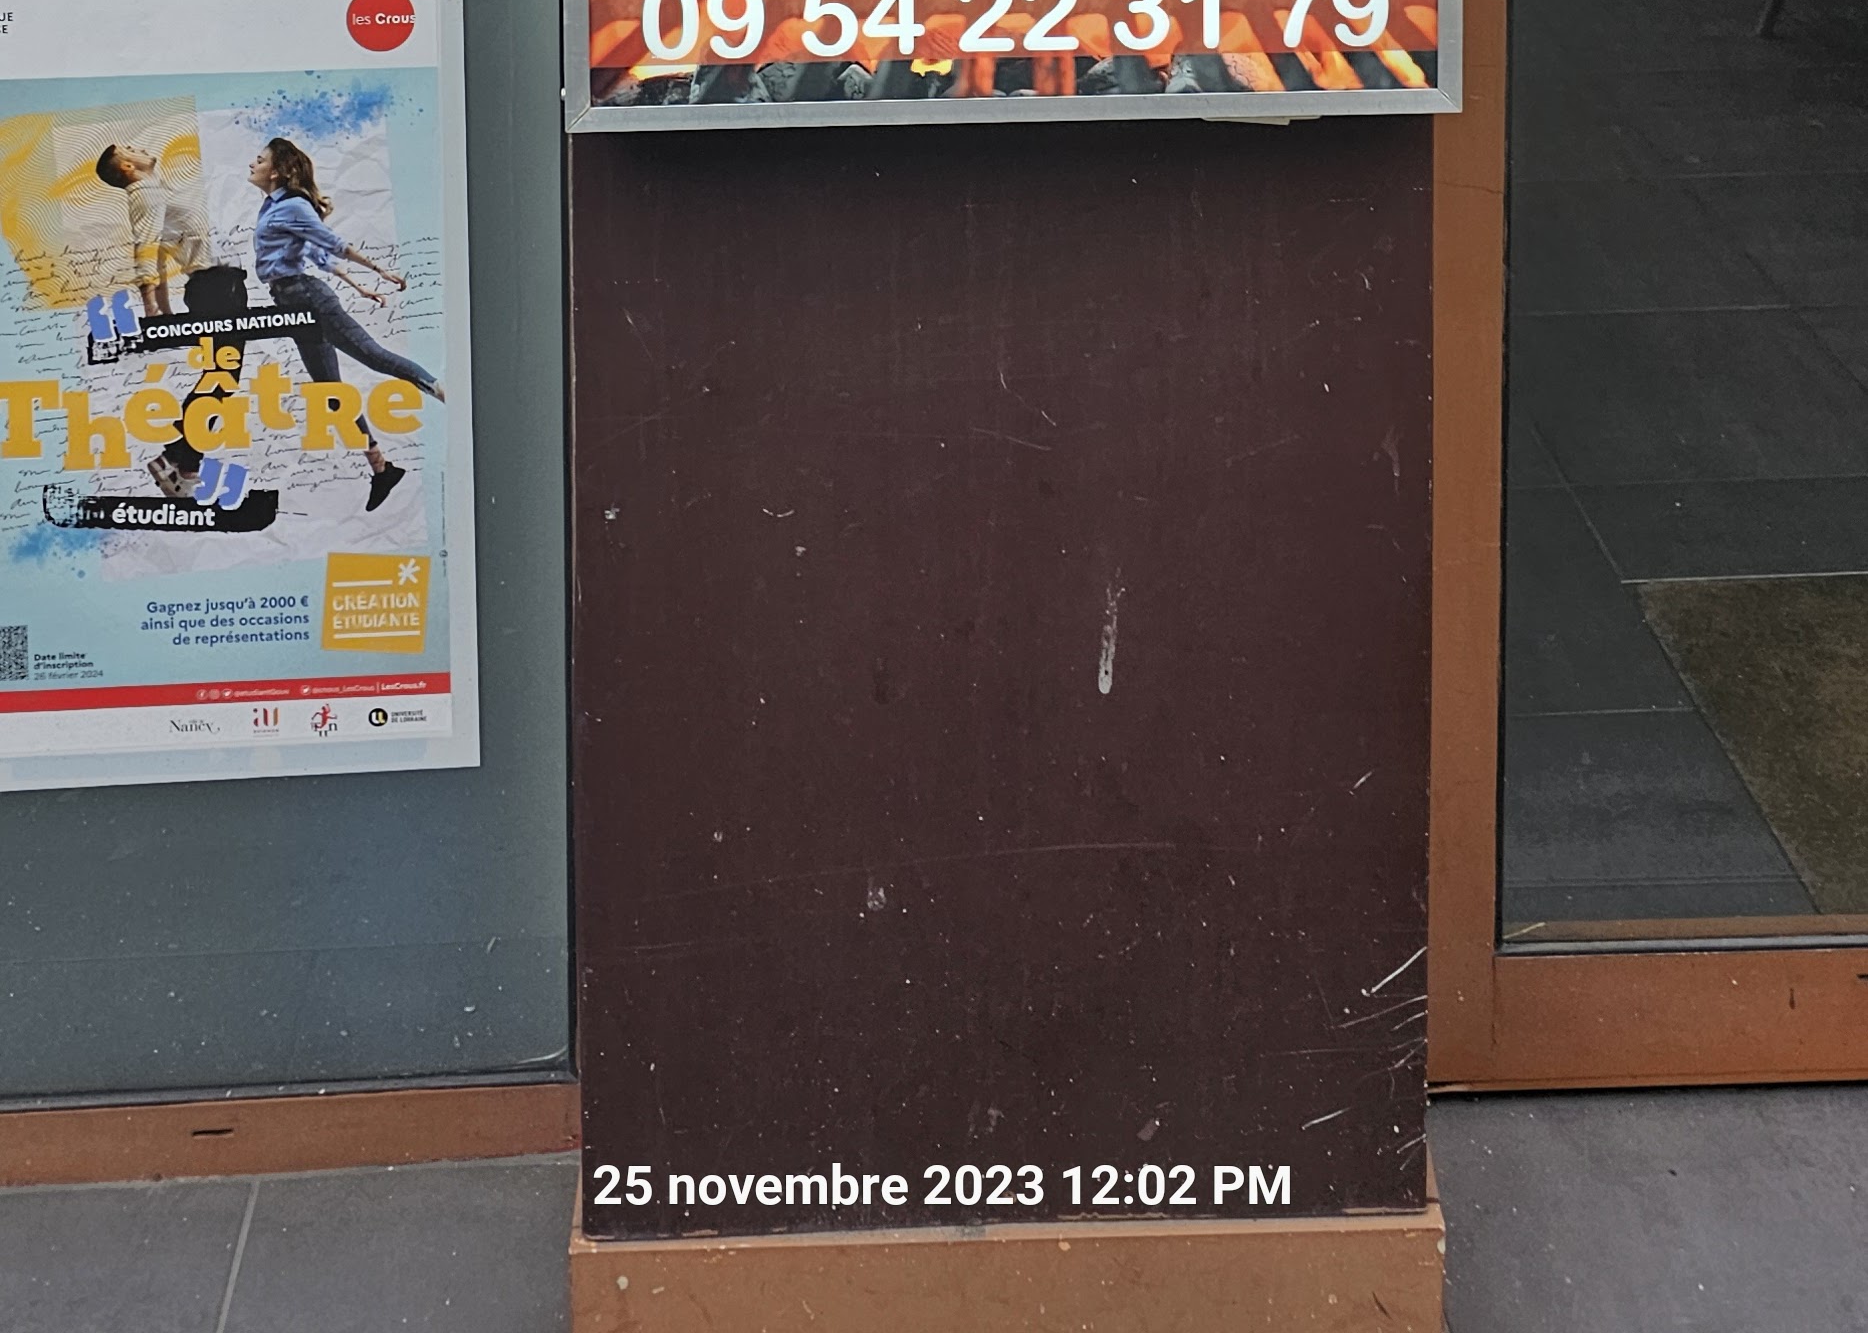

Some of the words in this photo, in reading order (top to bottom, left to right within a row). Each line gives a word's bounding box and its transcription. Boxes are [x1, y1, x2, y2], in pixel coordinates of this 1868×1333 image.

[352, 13, 370, 25] les
[375, 12, 415, 25] Crous
[146, 320, 233, 340] CONCOURS
[236, 310, 315, 332] NATIONAL
[187, 338, 241, 370] de
[112, 503, 215, 528] étudiant
[146, 600, 201, 615] Gagnez
[260, 596, 295, 608] 2000
[300, 595, 309, 607] €
[332, 590, 419, 611] CRÉATION
[140, 617, 174, 631] ainsi
[178, 617, 205, 631] que
[210, 613, 234, 628] des
[239, 612, 309, 627] occasions
[332, 610, 419, 629] ÉTUDIANTE
[172, 631, 191, 646] de
[194, 628, 309, 648] représentations
